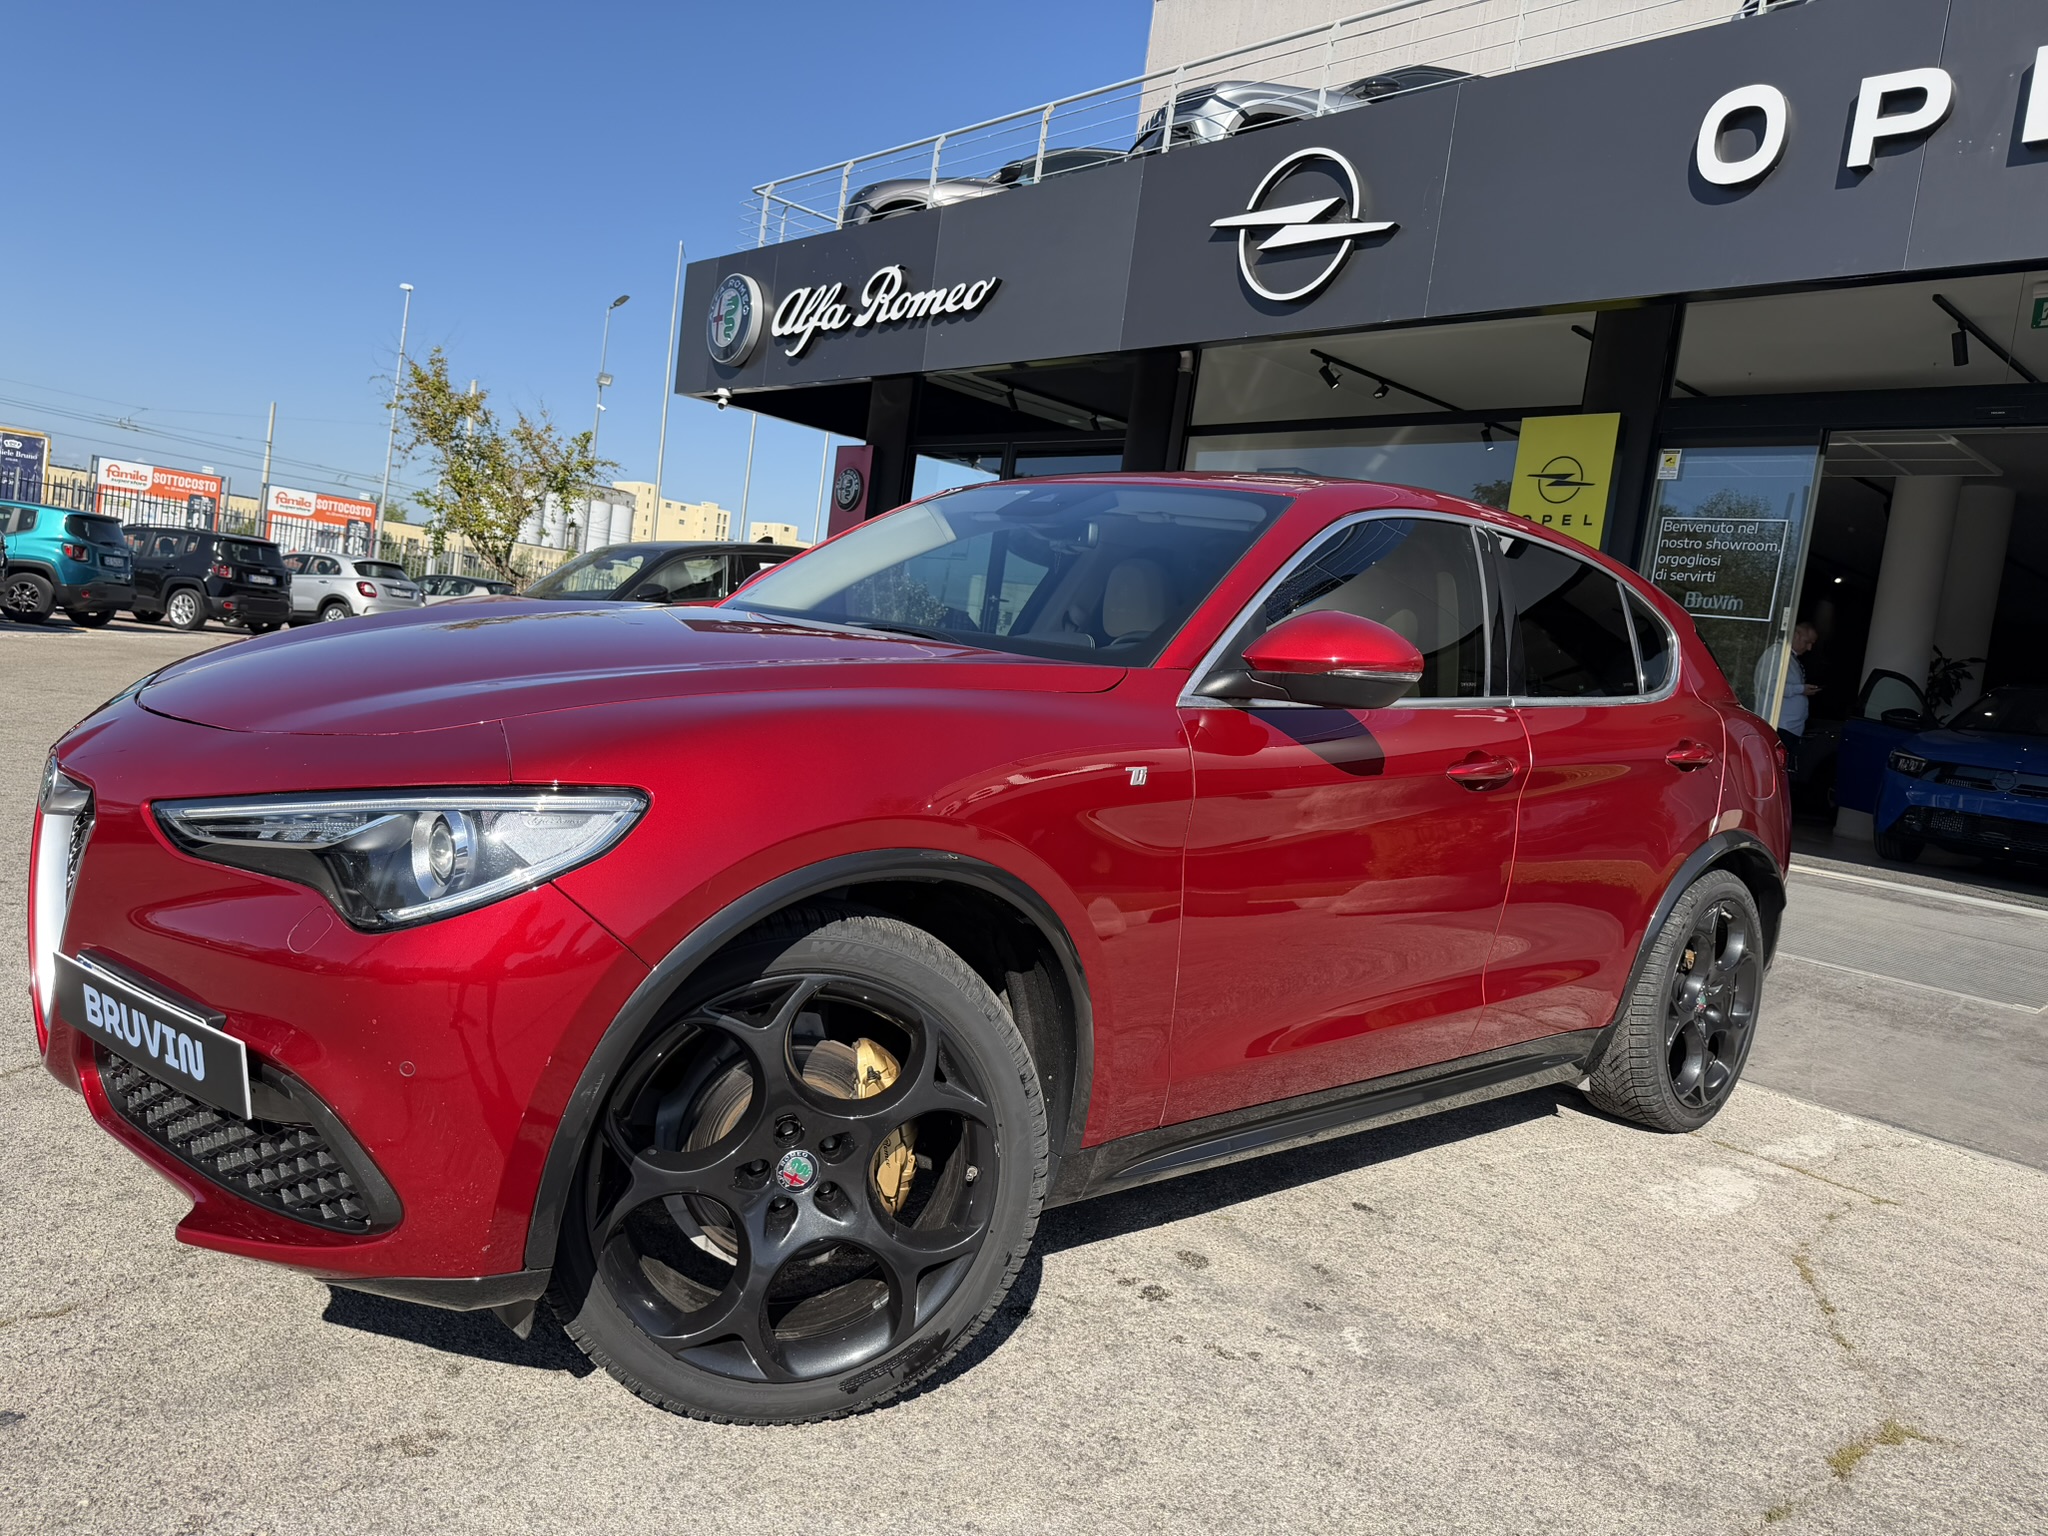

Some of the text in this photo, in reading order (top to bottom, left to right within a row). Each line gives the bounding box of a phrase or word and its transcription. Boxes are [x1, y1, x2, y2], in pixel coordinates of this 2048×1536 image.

[1697, 46, 2048, 185] OP
[728, 279, 750, 316] ROMEO
[771, 264, 997, 357] Alfa Romeo
[106, 464, 148, 482] famila
[153, 472, 217, 493] SOTTOCOSTO
[275, 492, 312, 508] famila
[316, 499, 372, 517] SOTTOCOSTO
[1663, 521, 1759, 535] Benvenuto nel
[1660, 537, 1782, 553] nostro showroom,
[1658, 554, 1722, 568] orgogliosi
[1655, 569, 1716, 583] di servirti
[83, 983, 206, 1081] BRUVIN
